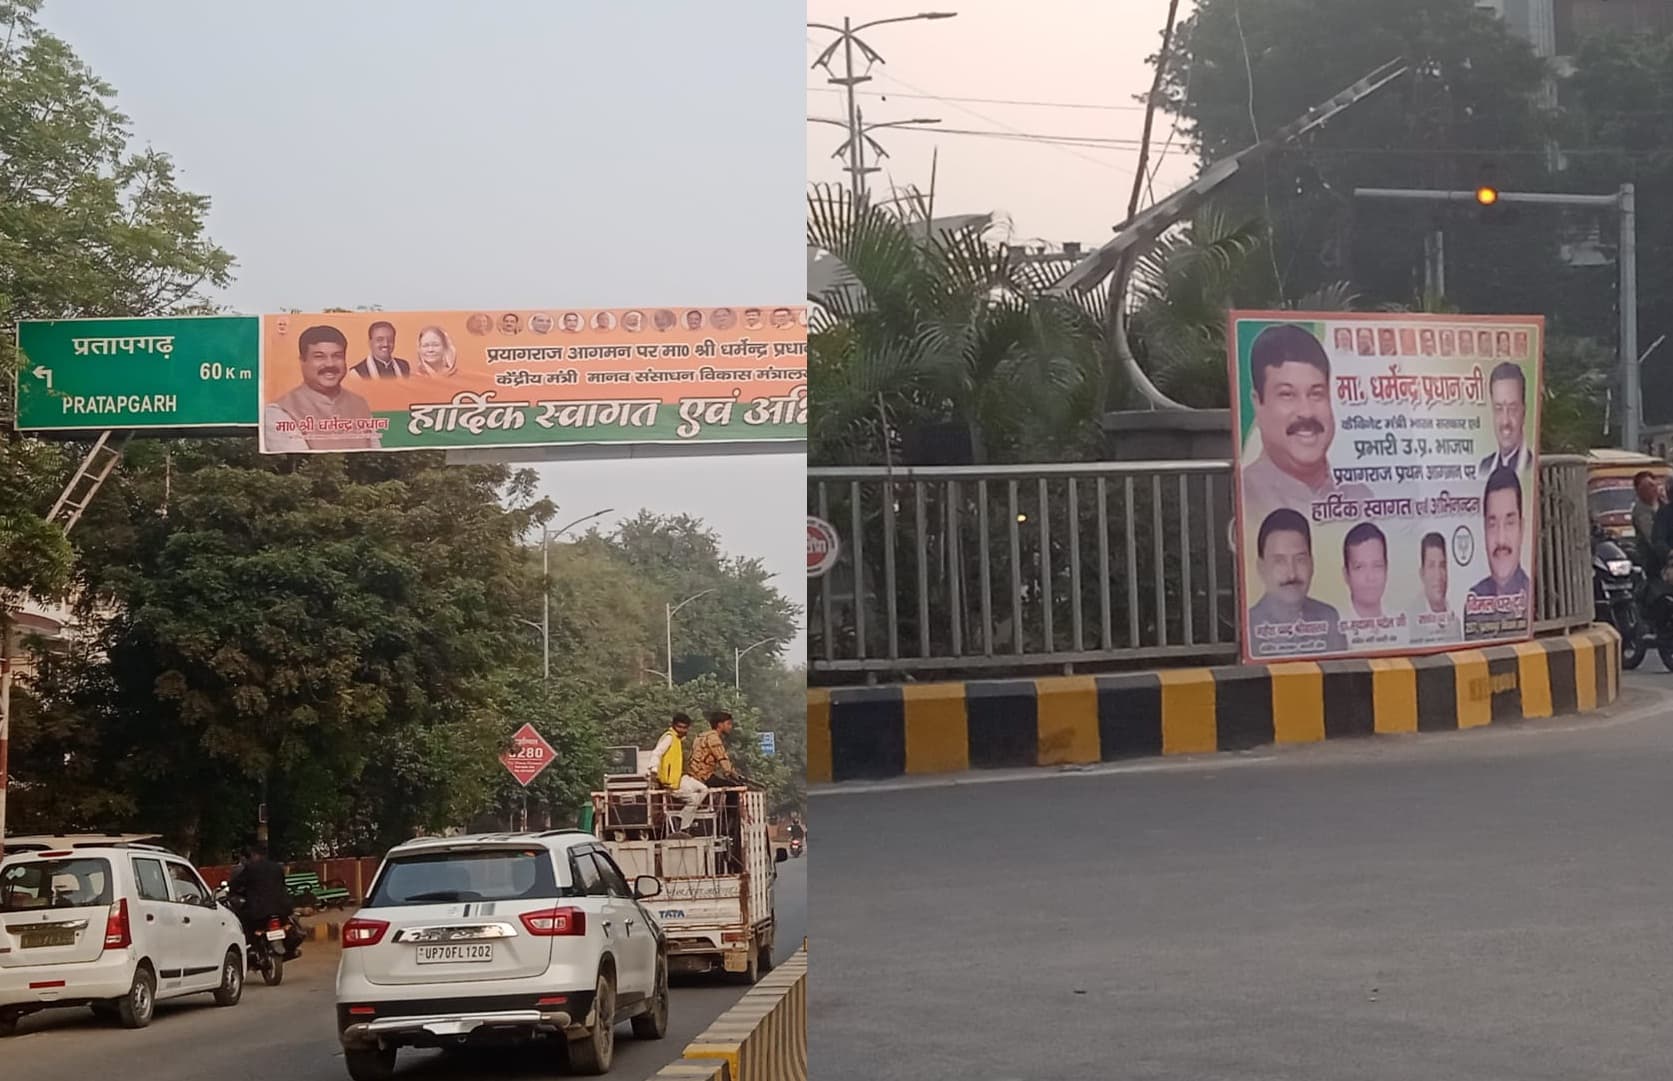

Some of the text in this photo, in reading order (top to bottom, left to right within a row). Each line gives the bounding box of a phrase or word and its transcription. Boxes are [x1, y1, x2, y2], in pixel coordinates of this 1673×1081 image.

[72, 336, 175, 359] प्रतापगढ़
[487, 347, 563, 363] प्रयागराज
[567, 345, 631, 359] आगमन
[636, 345, 659, 357] पर
[695, 339, 716, 357] श्री
[199, 363, 222, 380] 60
[546, 369, 578, 384] मंत्री
[587, 371, 631, 383] मानव
[635, 368, 695, 382] संसाधन
[700, 366, 752, 380] विकास
[1464, 366, 1485, 401] जी
[63, 395, 177, 414] PRATAPGARH
[408, 390, 531, 436] हार्दिक
[535, 398, 663, 428] स्वागत
[676, 387, 742, 439] एवं
[299, 416, 314, 434] श्री
[1353, 432, 1397, 460] प्रभारी
[1435, 438, 1475, 455] भाजपा
[1333, 466, 1392, 486] प्रयागराज
[1463, 464, 1478, 482] पर
[1311, 493, 1359, 522] हार्दिक
[1363, 498, 1412, 517] स्वागत
[508, 747, 544, 758] 280
[658, 909, 686, 919] TATA
